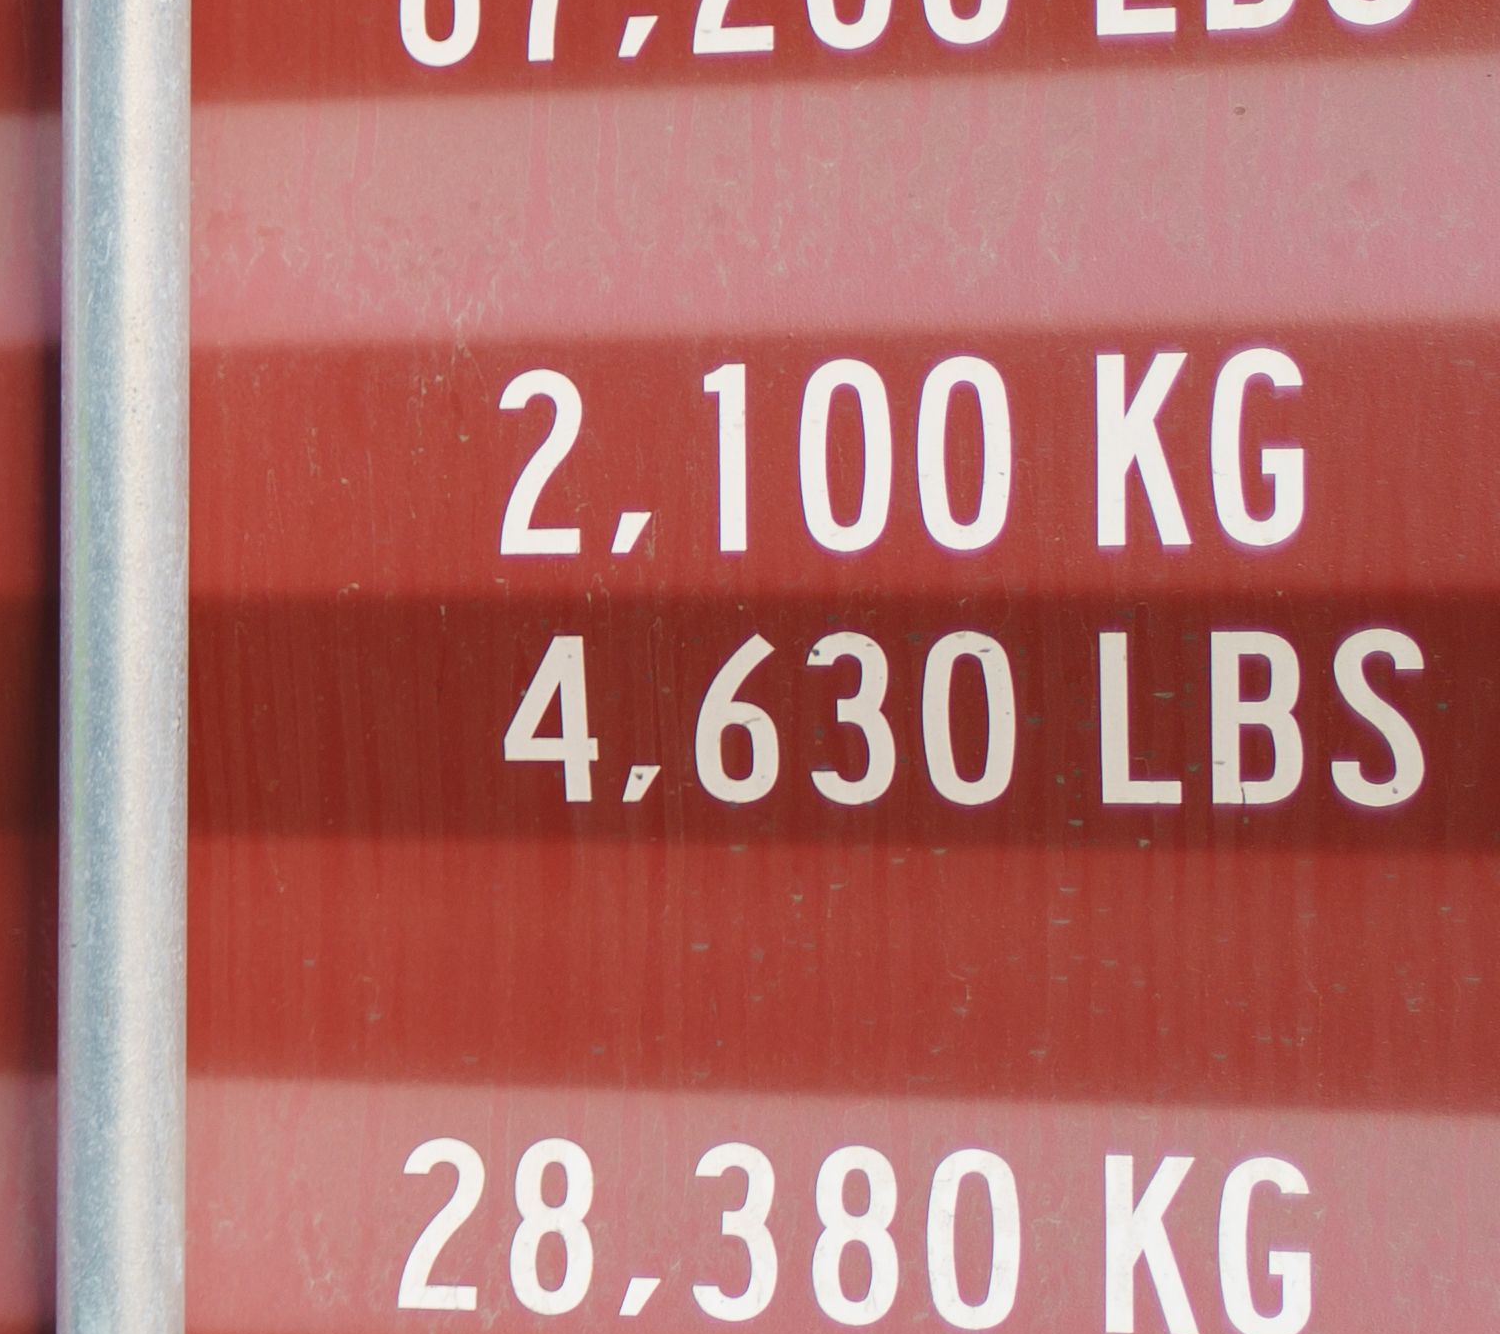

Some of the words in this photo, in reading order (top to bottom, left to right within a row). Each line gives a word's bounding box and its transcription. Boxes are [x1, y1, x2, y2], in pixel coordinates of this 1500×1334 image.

[498, 354, 1013, 557] 2,100
[1095, 346, 1307, 553] KG
[503, 629, 1016, 806] 4,630
[1098, 627, 1426, 808] LBS
[396, 1136, 1023, 1332] 28,380
